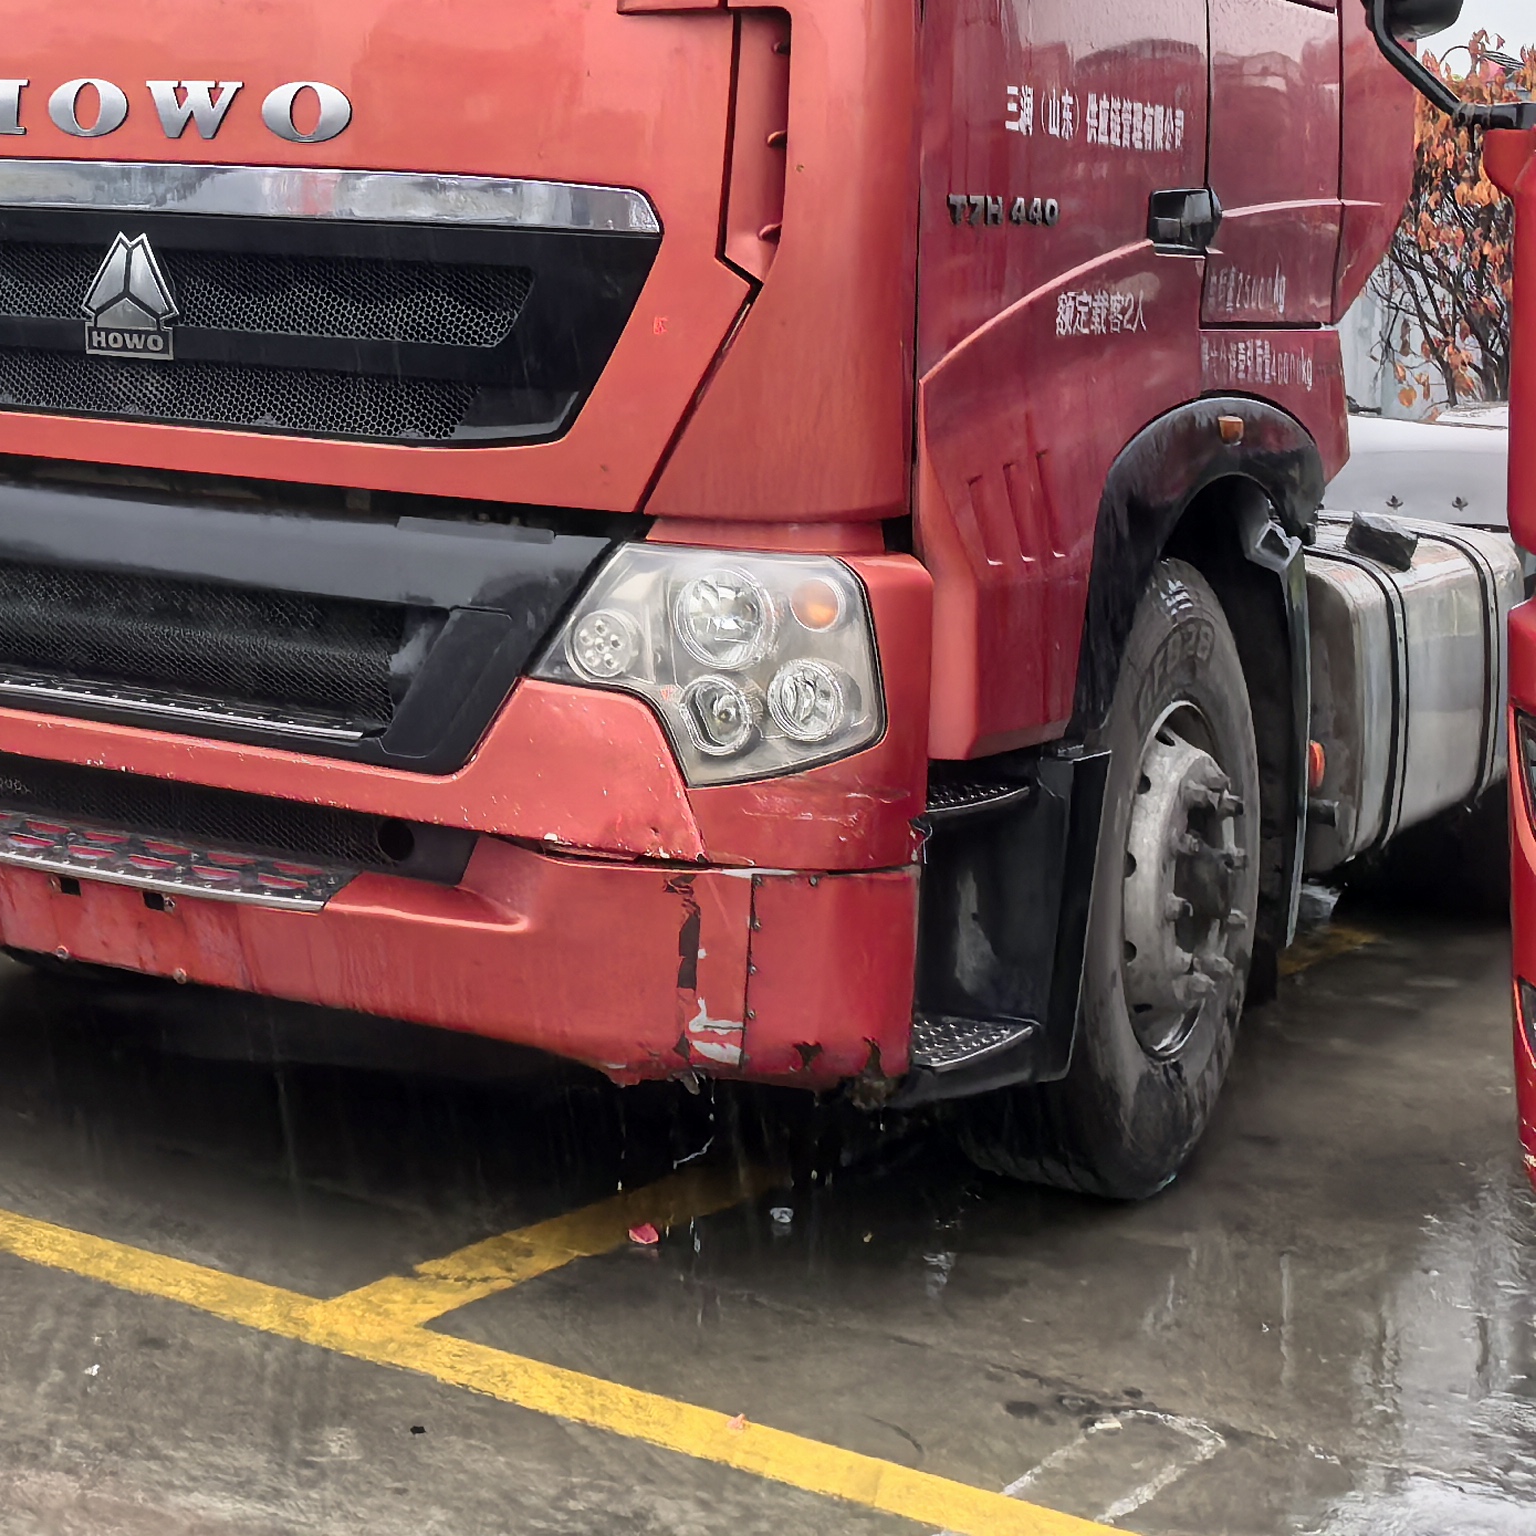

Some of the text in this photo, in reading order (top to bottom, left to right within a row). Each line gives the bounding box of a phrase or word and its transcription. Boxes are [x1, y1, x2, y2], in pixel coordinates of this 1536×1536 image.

[947, 194, 1060, 226] T7H 440
[1056, 289, 1147, 336] 额定载客2人
[91, 330, 164, 352] HOWO
